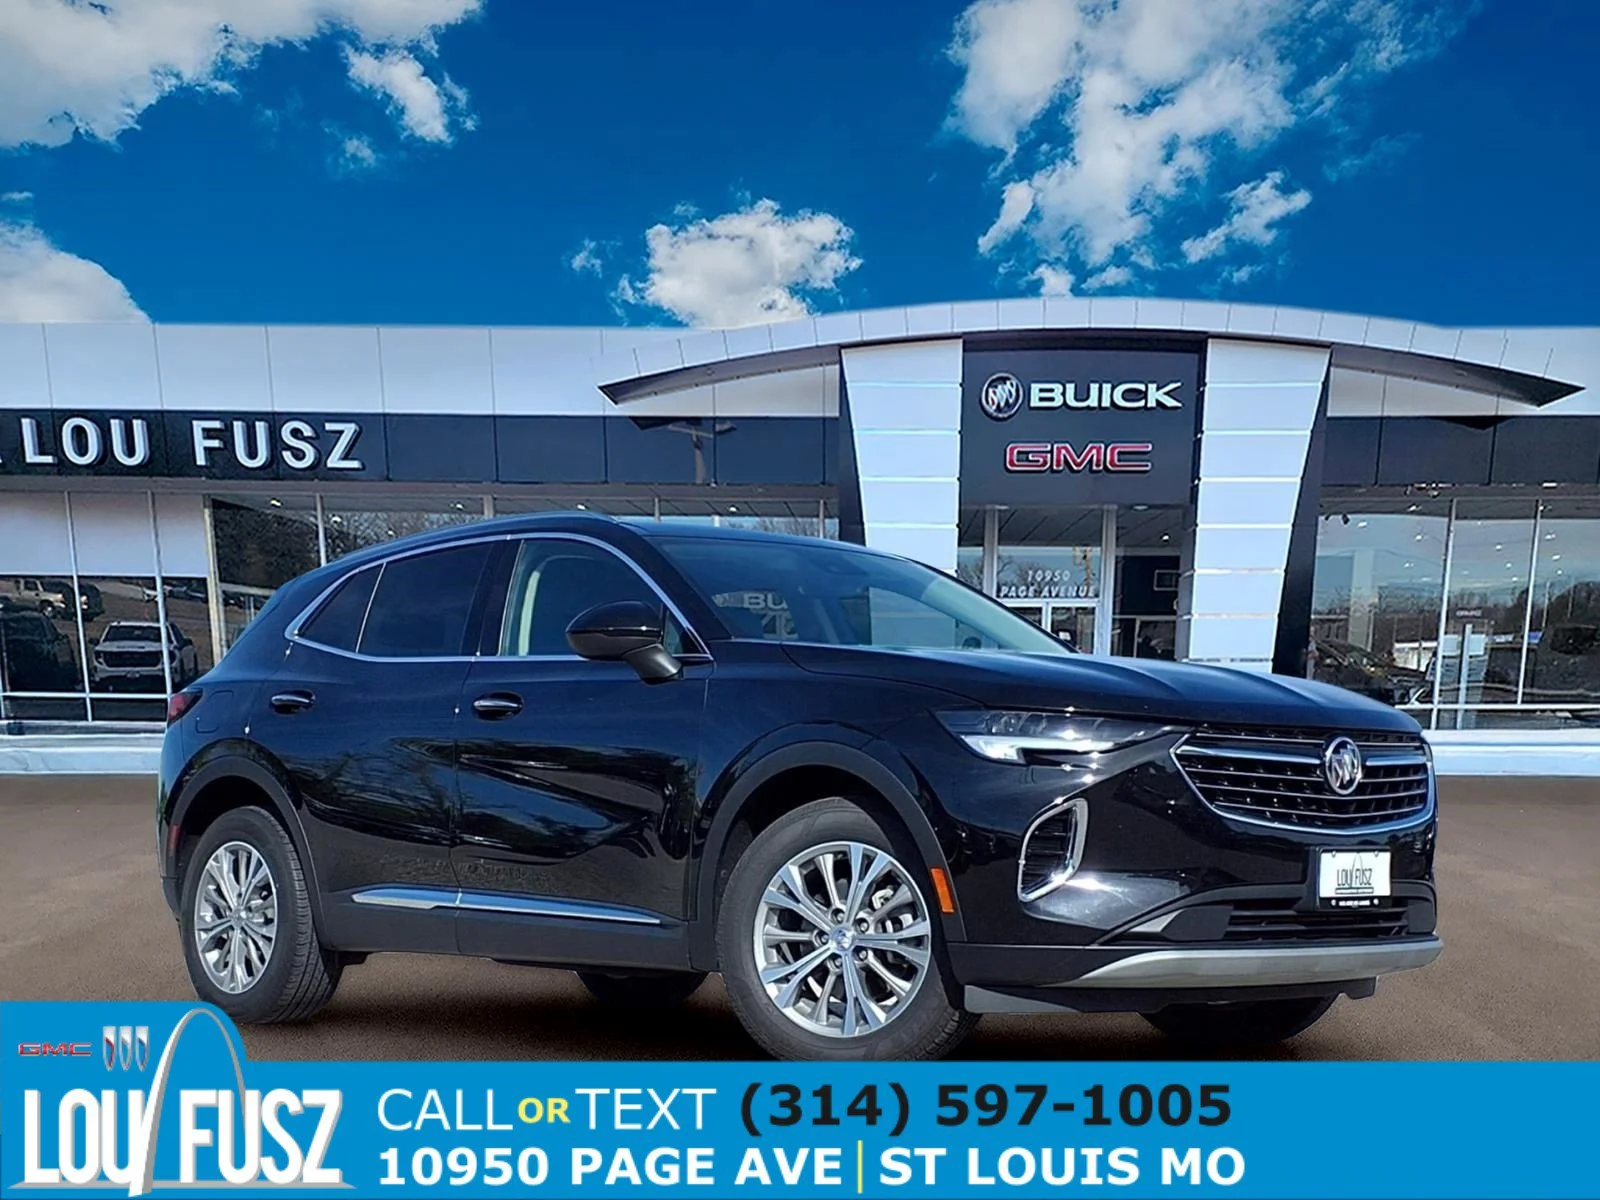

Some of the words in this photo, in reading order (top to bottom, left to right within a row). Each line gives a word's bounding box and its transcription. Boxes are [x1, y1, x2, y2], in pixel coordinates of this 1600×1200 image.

[1029, 381, 1182, 409] BUICK
[20, 417, 150, 467] LOU
[192, 419, 364, 470] FUSZ
[1005, 442, 1153, 473] GMC
[1027, 569, 1072, 582] 10950
[1000, 585, 1035, 598] PAGE
[1041, 585, 1096, 598] AVENUE
[1336, 868, 1352, 887] LOU
[1355, 867, 1373, 886] FUSZ
